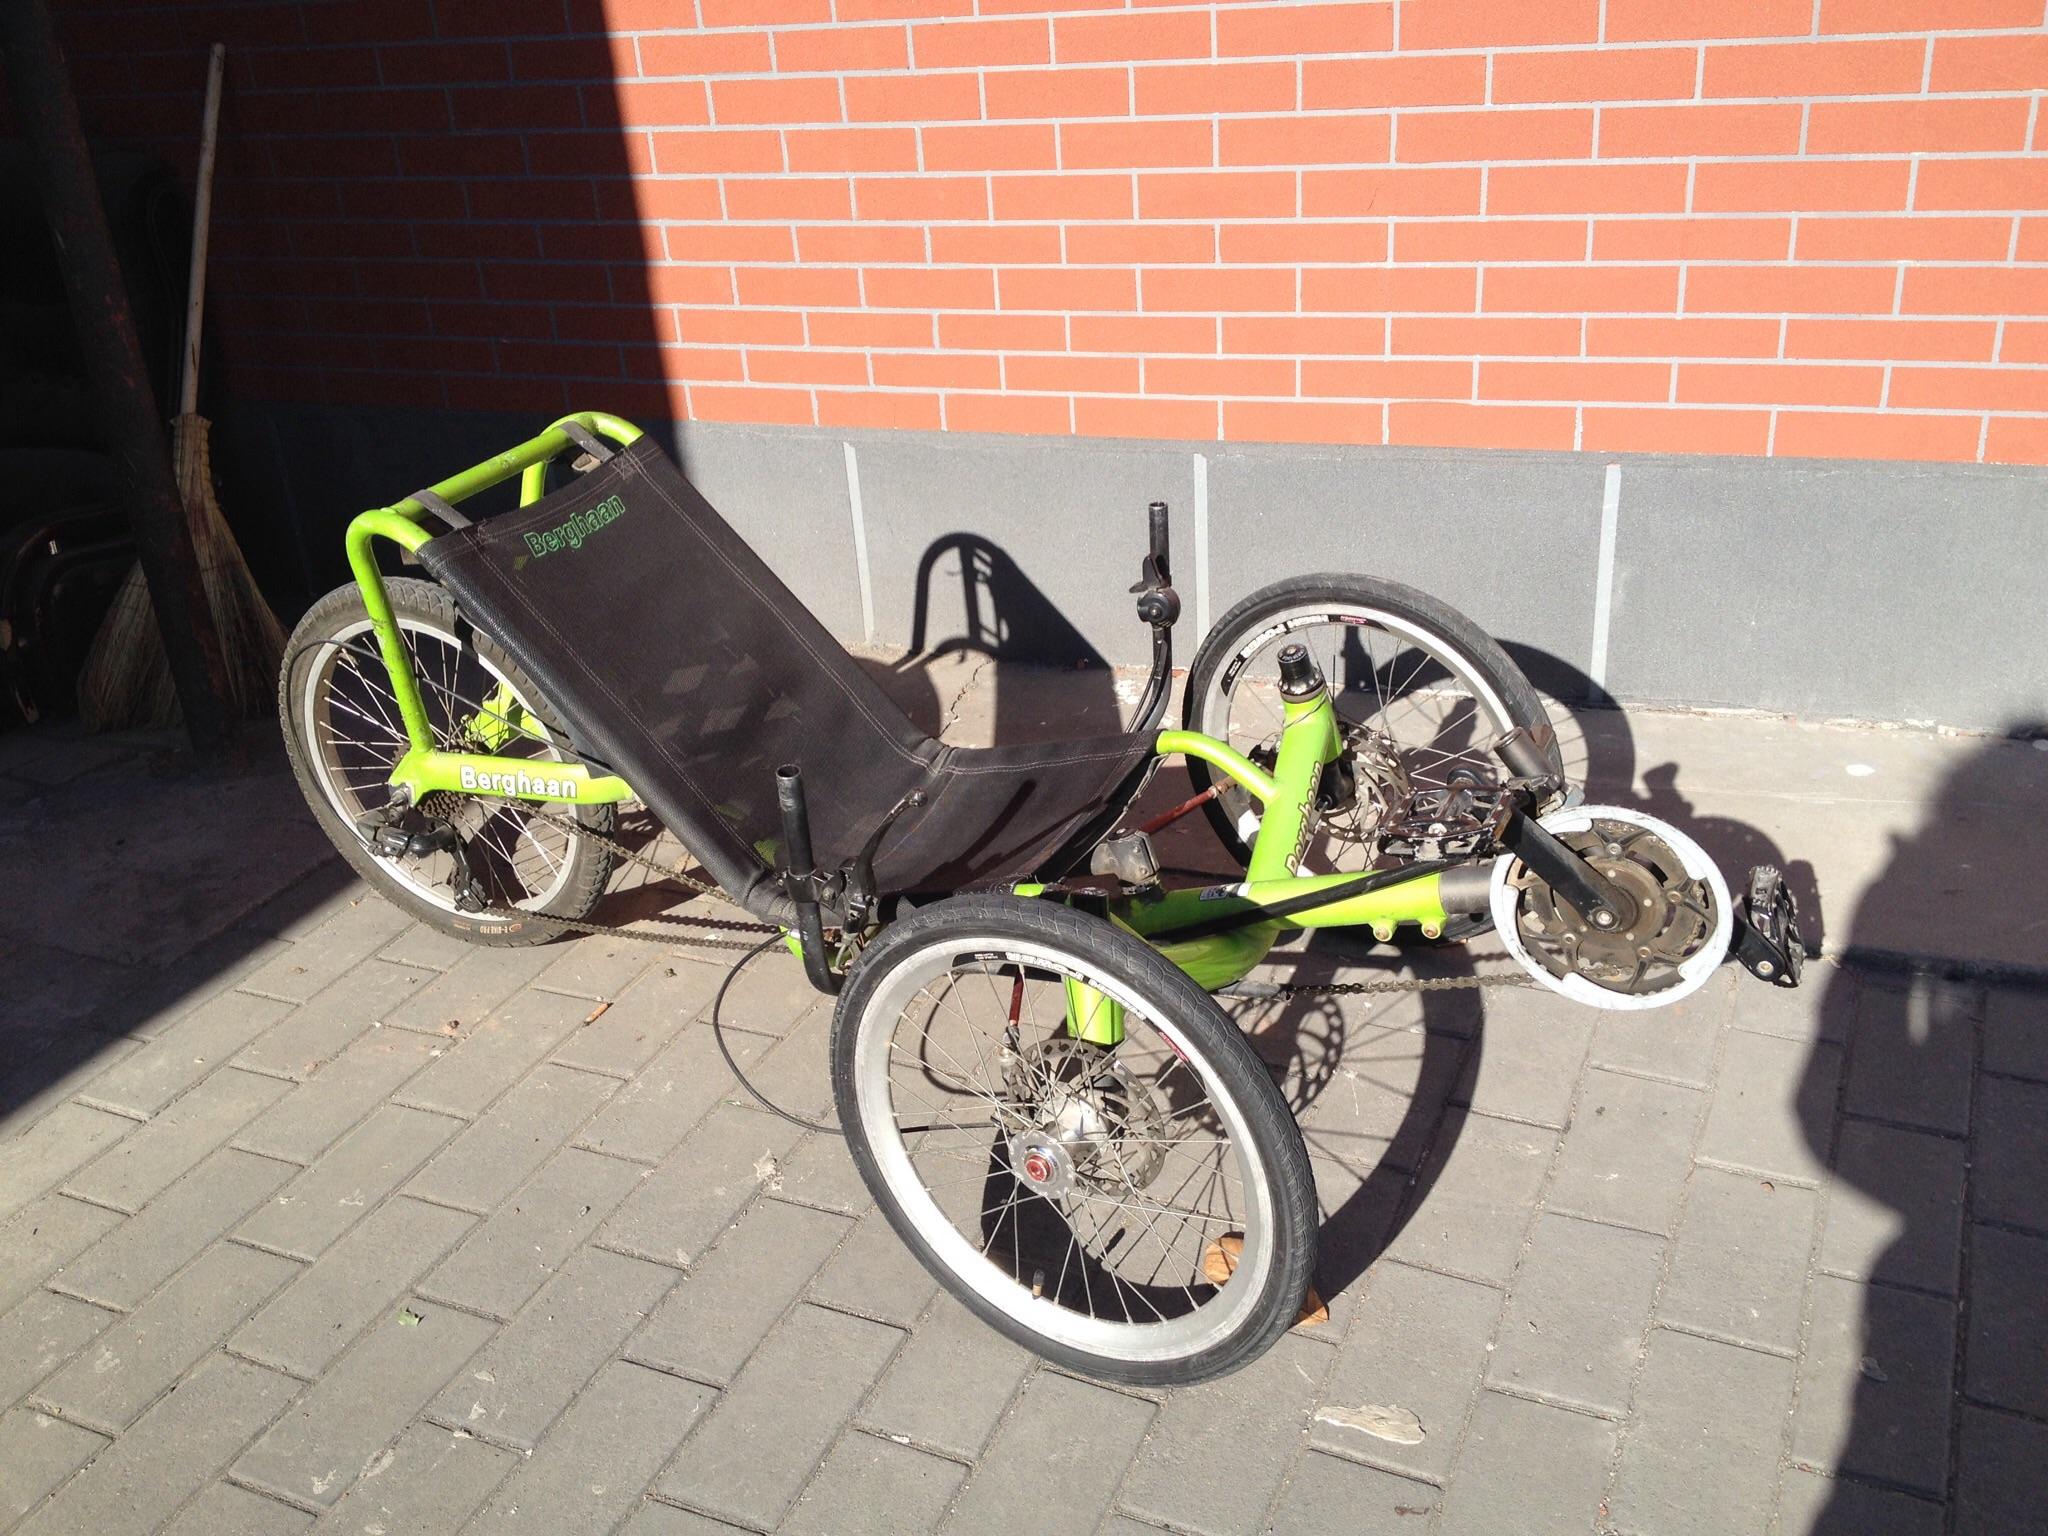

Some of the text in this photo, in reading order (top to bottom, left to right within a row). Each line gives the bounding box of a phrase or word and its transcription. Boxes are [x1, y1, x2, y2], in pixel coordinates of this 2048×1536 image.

[523, 495, 626, 558] Berghaan
[1240, 623, 1287, 659] POWER
[460, 765, 577, 798] Berghaan
[1005, 951, 1085, 982] POWER
